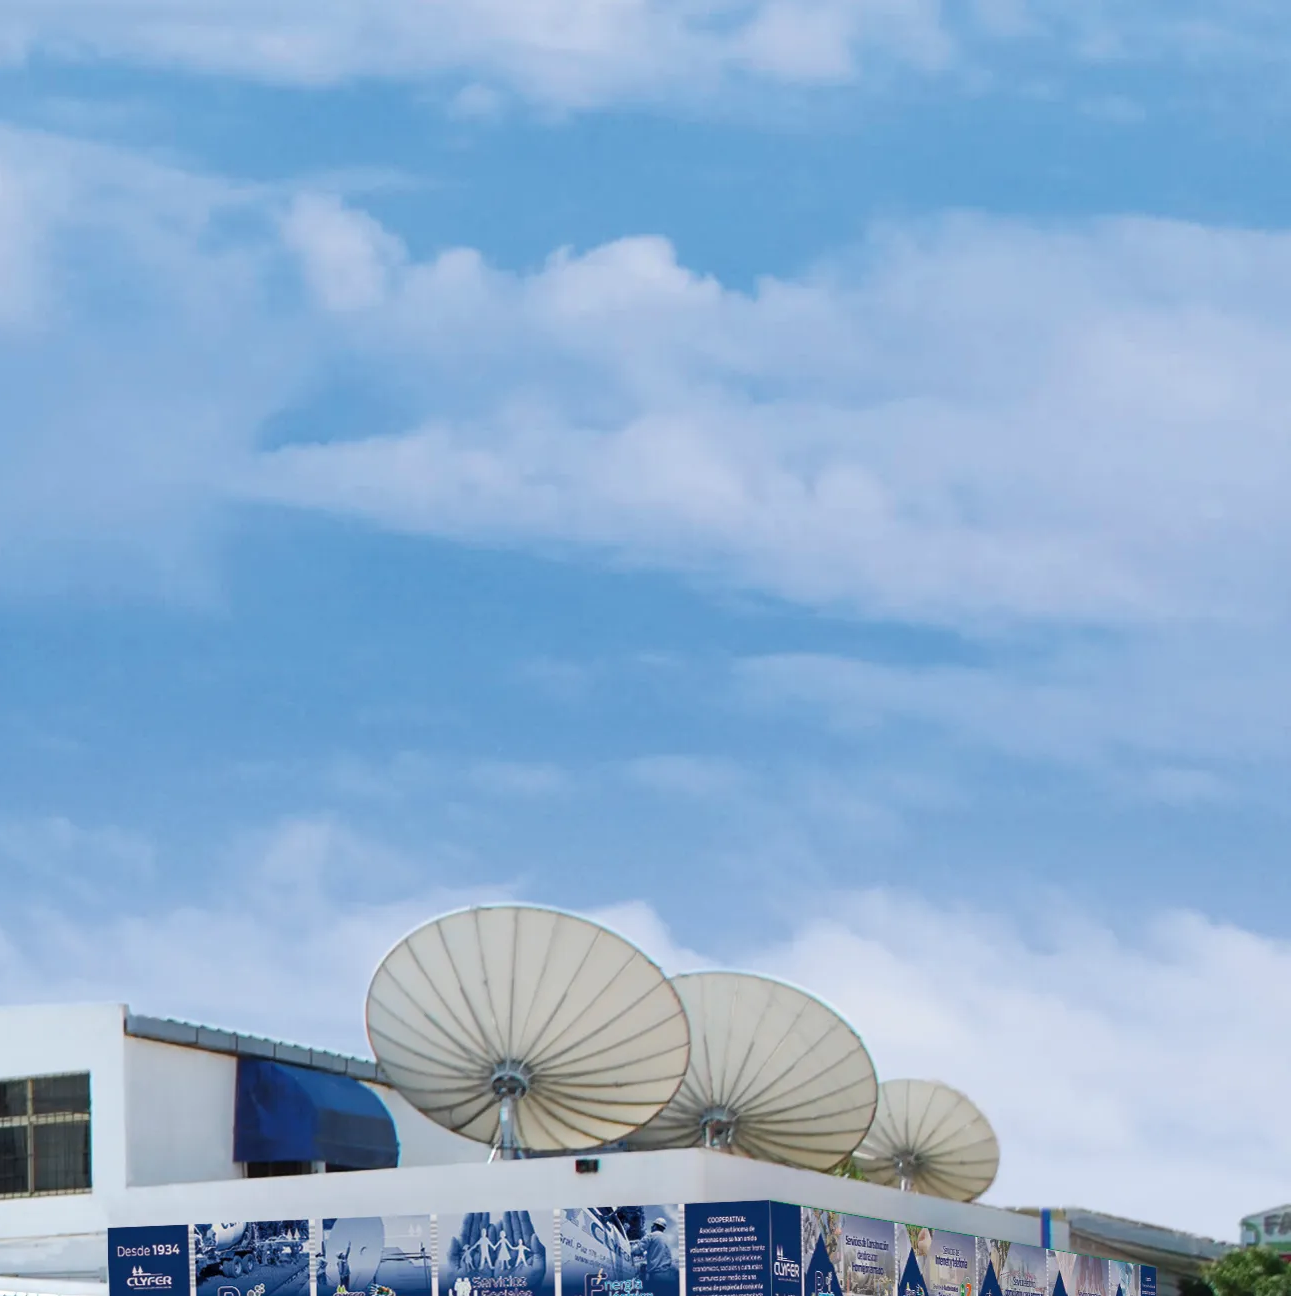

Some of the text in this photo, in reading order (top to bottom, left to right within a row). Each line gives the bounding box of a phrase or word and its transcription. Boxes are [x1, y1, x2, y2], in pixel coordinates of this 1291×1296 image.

[116, 1243, 180, 1257] Desde 1934
[773, 1261, 799, 1278] CLYFER
[126, 1275, 172, 1287] CLYFER
[472, 1275, 528, 1289] Servicios
